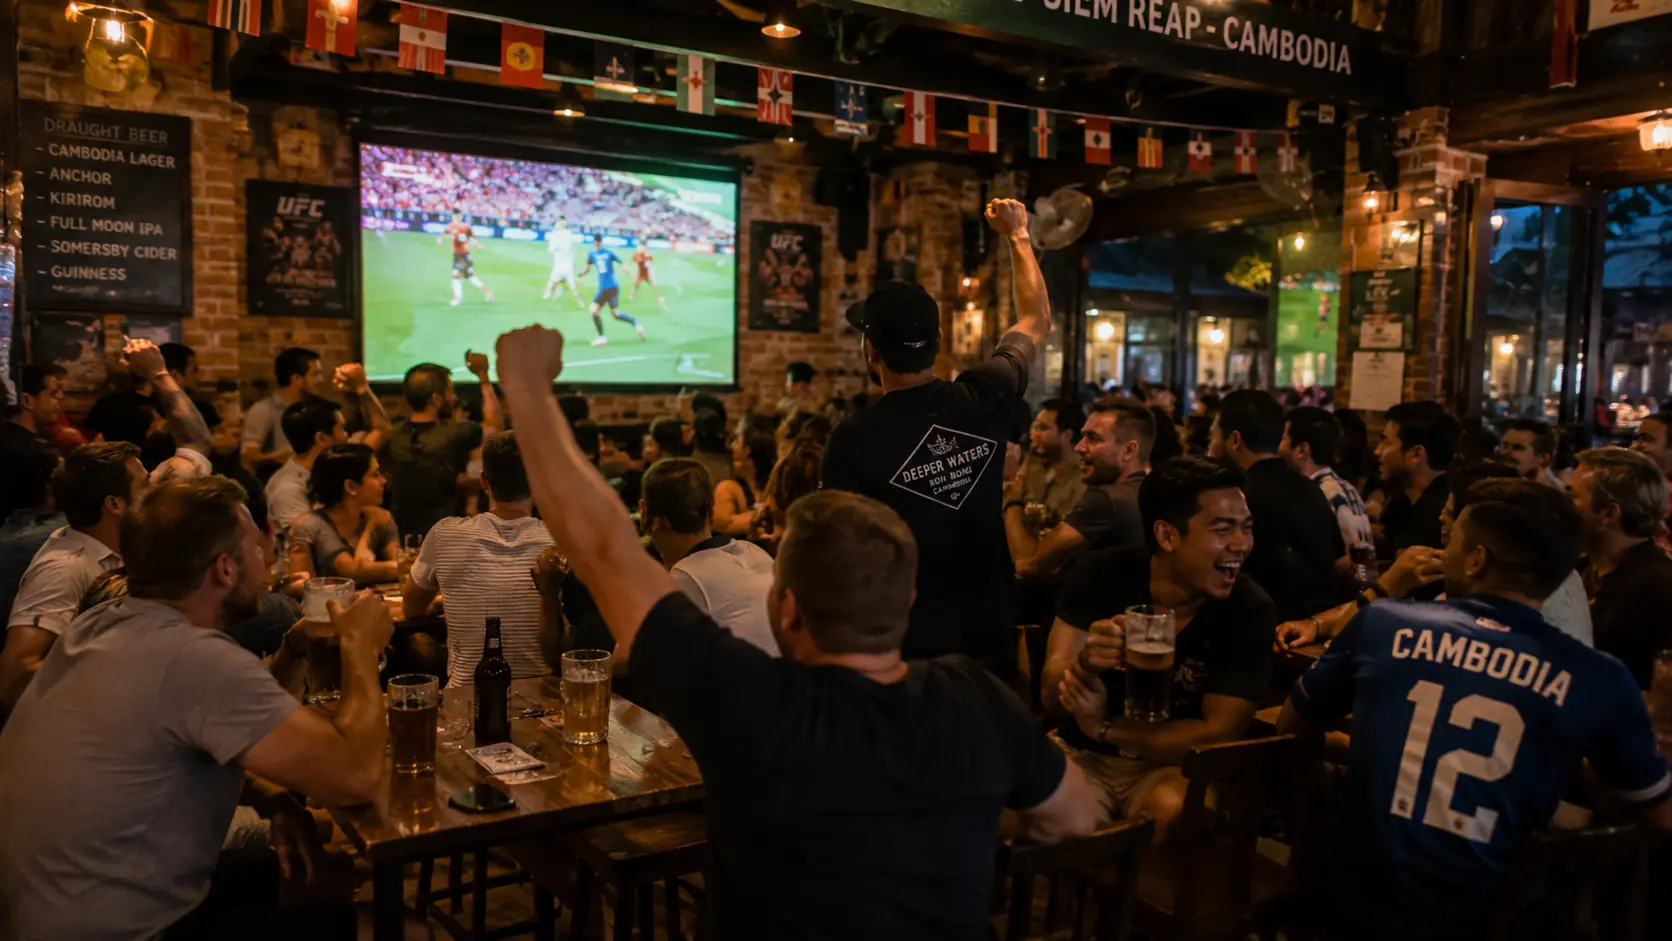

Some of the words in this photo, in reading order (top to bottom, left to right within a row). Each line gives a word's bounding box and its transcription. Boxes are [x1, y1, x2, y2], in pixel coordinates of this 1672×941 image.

[1128, 0, 1201, 40] REAP
[1224, 18, 1351, 75] CAMBODIA
[45, 119, 121, 138] DRAUGHT
[129, 128, 168, 144] BEER
[49, 144, 124, 163] CAMBODIA
[130, 153, 175, 168] LAGER
[50, 168, 112, 184] ANCHOR
[51, 192, 115, 209] KIRIROM
[277, 195, 326, 218] UFC
[51, 216, 86, 230] FULL
[92, 220, 133, 232] MOON
[140, 223, 163, 235] IPA
[51, 241, 128, 258] SOMERSBY
[134, 248, 177, 260] CIDER
[770, 232, 805, 251] UFC
[51, 265, 126, 280] GUINNESS
[903, 460, 944, 483] DEEPER
[947, 443, 989, 468] WATERS
[1392, 629, 1571, 706] CAMBODIA
[1389, 679, 1526, 844] 12
